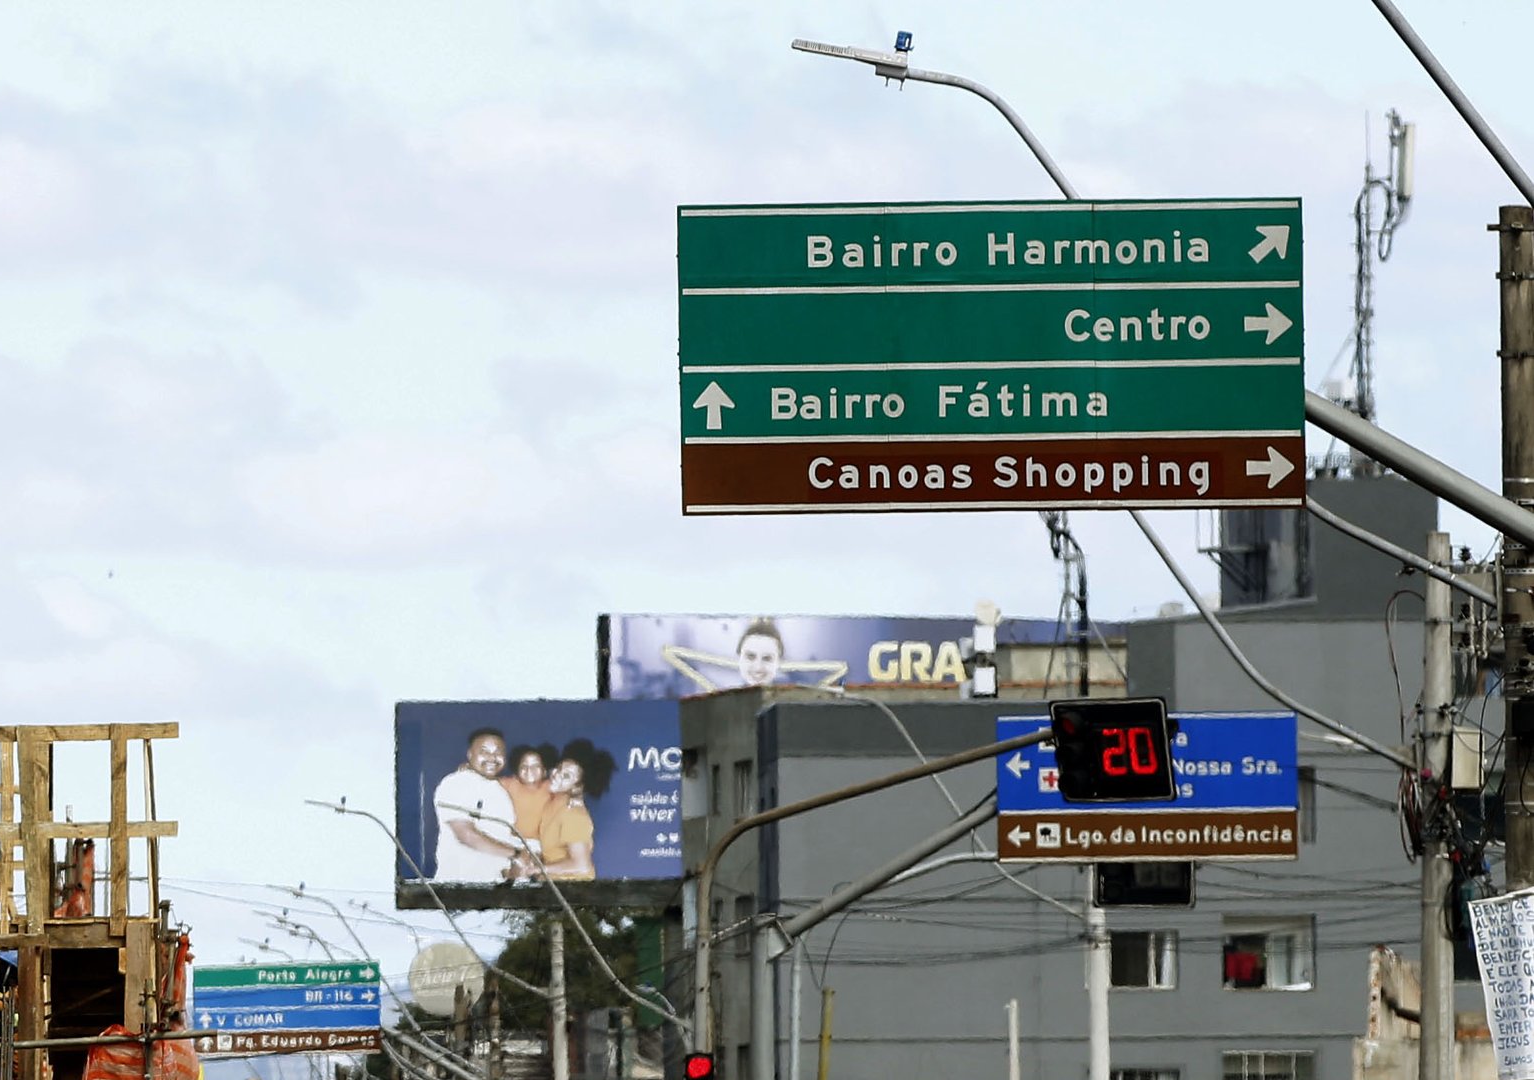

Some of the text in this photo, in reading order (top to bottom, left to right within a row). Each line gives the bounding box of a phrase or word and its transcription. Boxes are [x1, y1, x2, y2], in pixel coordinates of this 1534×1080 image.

[806, 232, 1210, 268] Bairro Harmonia
[1064, 308, 1211, 343] Centro
[771, 381, 1109, 420] Bairro Fátima
[808, 455, 1211, 496] Canoas Shopping
[1102, 727, 1158, 776] 20
[1173, 756, 1283, 776] Nossa Sra.
[1066, 824, 1293, 849] Lgo. da Inconfidência
[258, 968, 352, 983] Porto Alegre
[261, 1035, 322, 1048] Eduardo
[1498, 1034, 1530, 1050] JESUS
